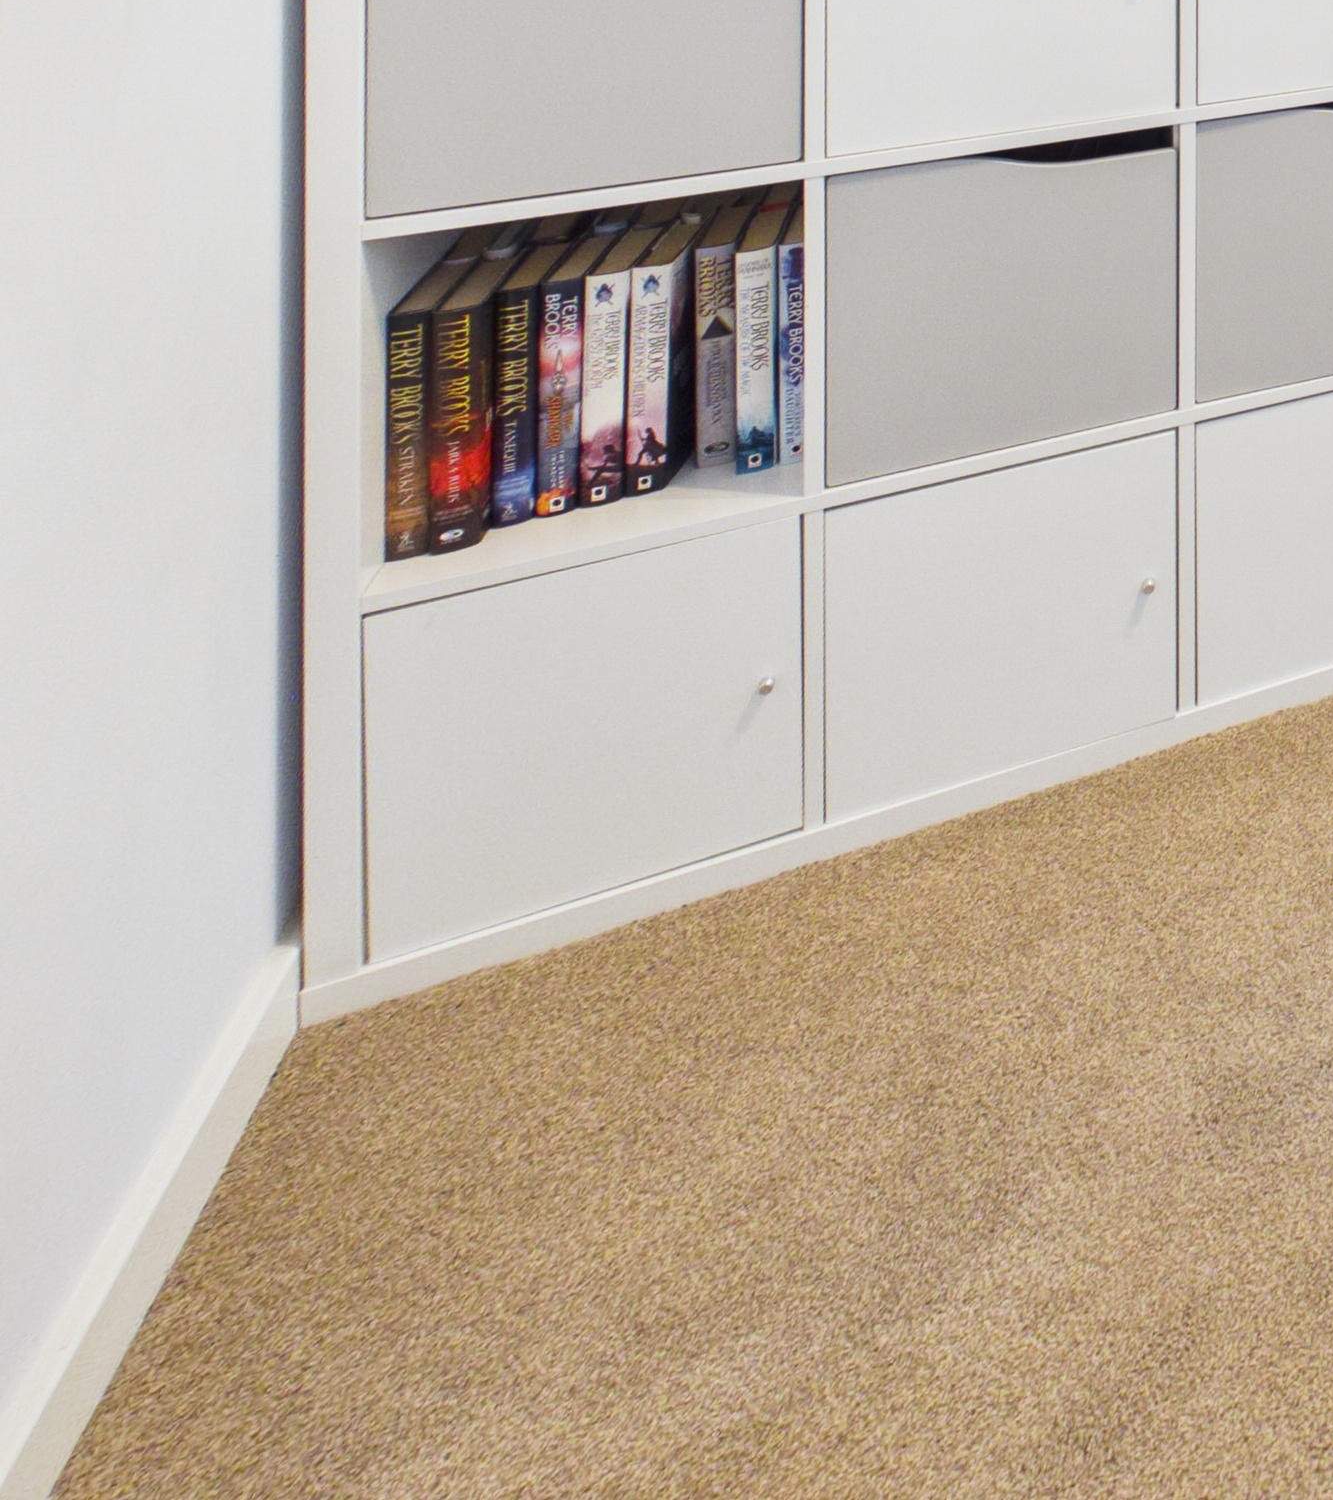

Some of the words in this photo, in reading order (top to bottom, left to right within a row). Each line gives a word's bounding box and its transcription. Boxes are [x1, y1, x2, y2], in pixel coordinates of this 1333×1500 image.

[500, 299, 528, 353] TERRY
[545, 293, 561, 350] BROOKS
[561, 295, 578, 338] TERRY
[649, 298, 668, 334] TERRY
[751, 282, 769, 319] TERRY
[788, 284, 803, 325] TERRY
[391, 324, 423, 379] TERRY
[438, 314, 470, 370] TERRY
[647, 335, 667, 383] BROOKS
[751, 321, 769, 371] BROOKS
[788, 328, 804, 385] BROOKS
[438, 375, 470, 437] BROOKS
[497, 357, 528, 417] BROOKS
[391, 384, 423, 445] BROOKS
